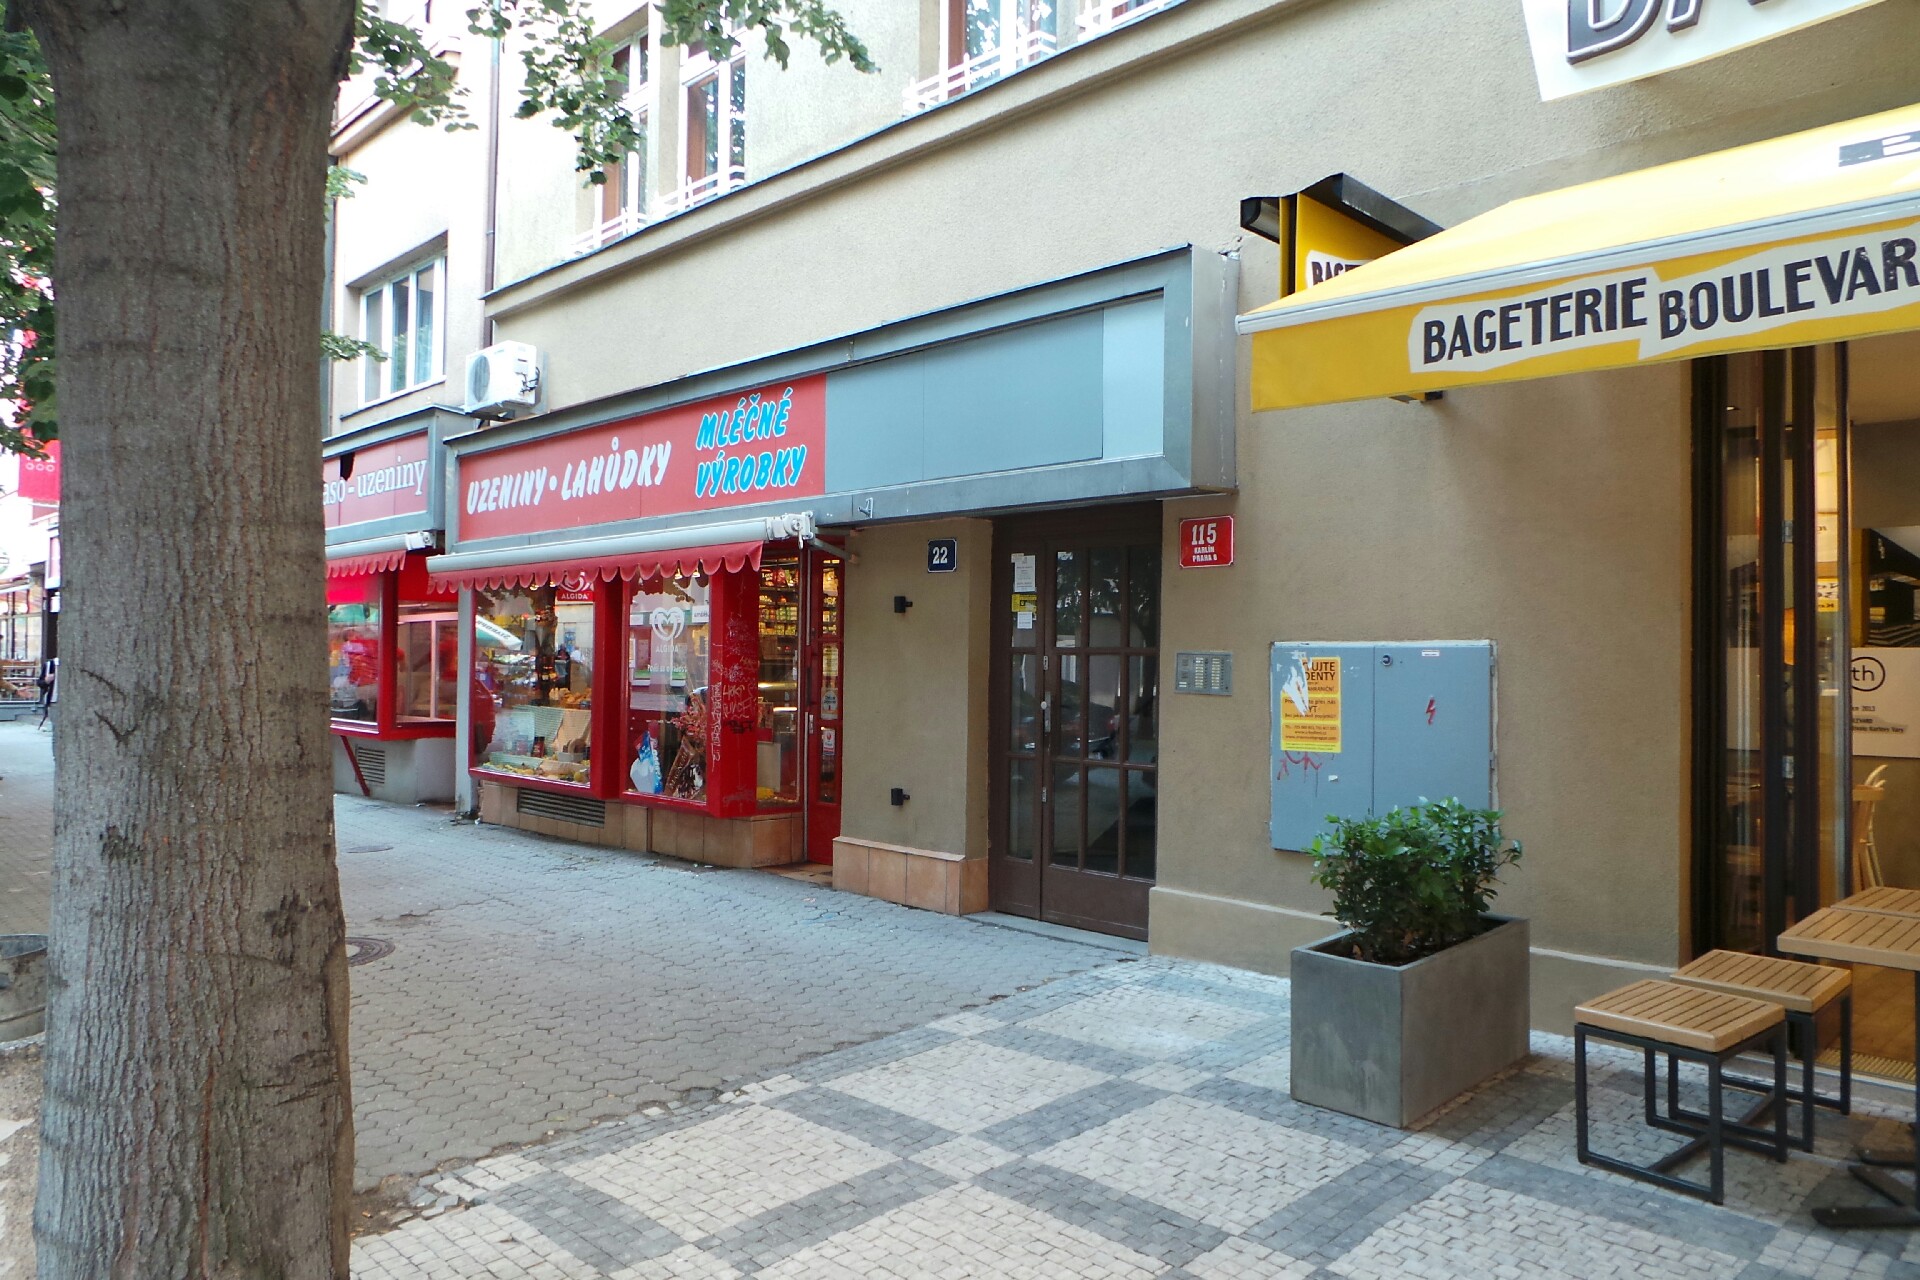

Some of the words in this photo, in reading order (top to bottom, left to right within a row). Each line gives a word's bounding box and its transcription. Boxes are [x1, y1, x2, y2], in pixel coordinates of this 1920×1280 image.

[1423, 277, 1647, 365] BAGETERIE
[1659, 236, 1920, 340] BOULEVAR
[695, 387, 794, 450] MLÉČNÉ
[356, 455, 428, 498] uzeniny
[466, 466, 547, 515] UZENINY
[561, 436, 672, 500] LAHŮDKY
[695, 444, 807, 498] VÝROBKY
[932, 546, 948, 565] 22
[1191, 522, 1217, 546] 115
[1193, 545, 1215, 555] KARLÍN
[1192, 554, 1212, 563] PRAHA
